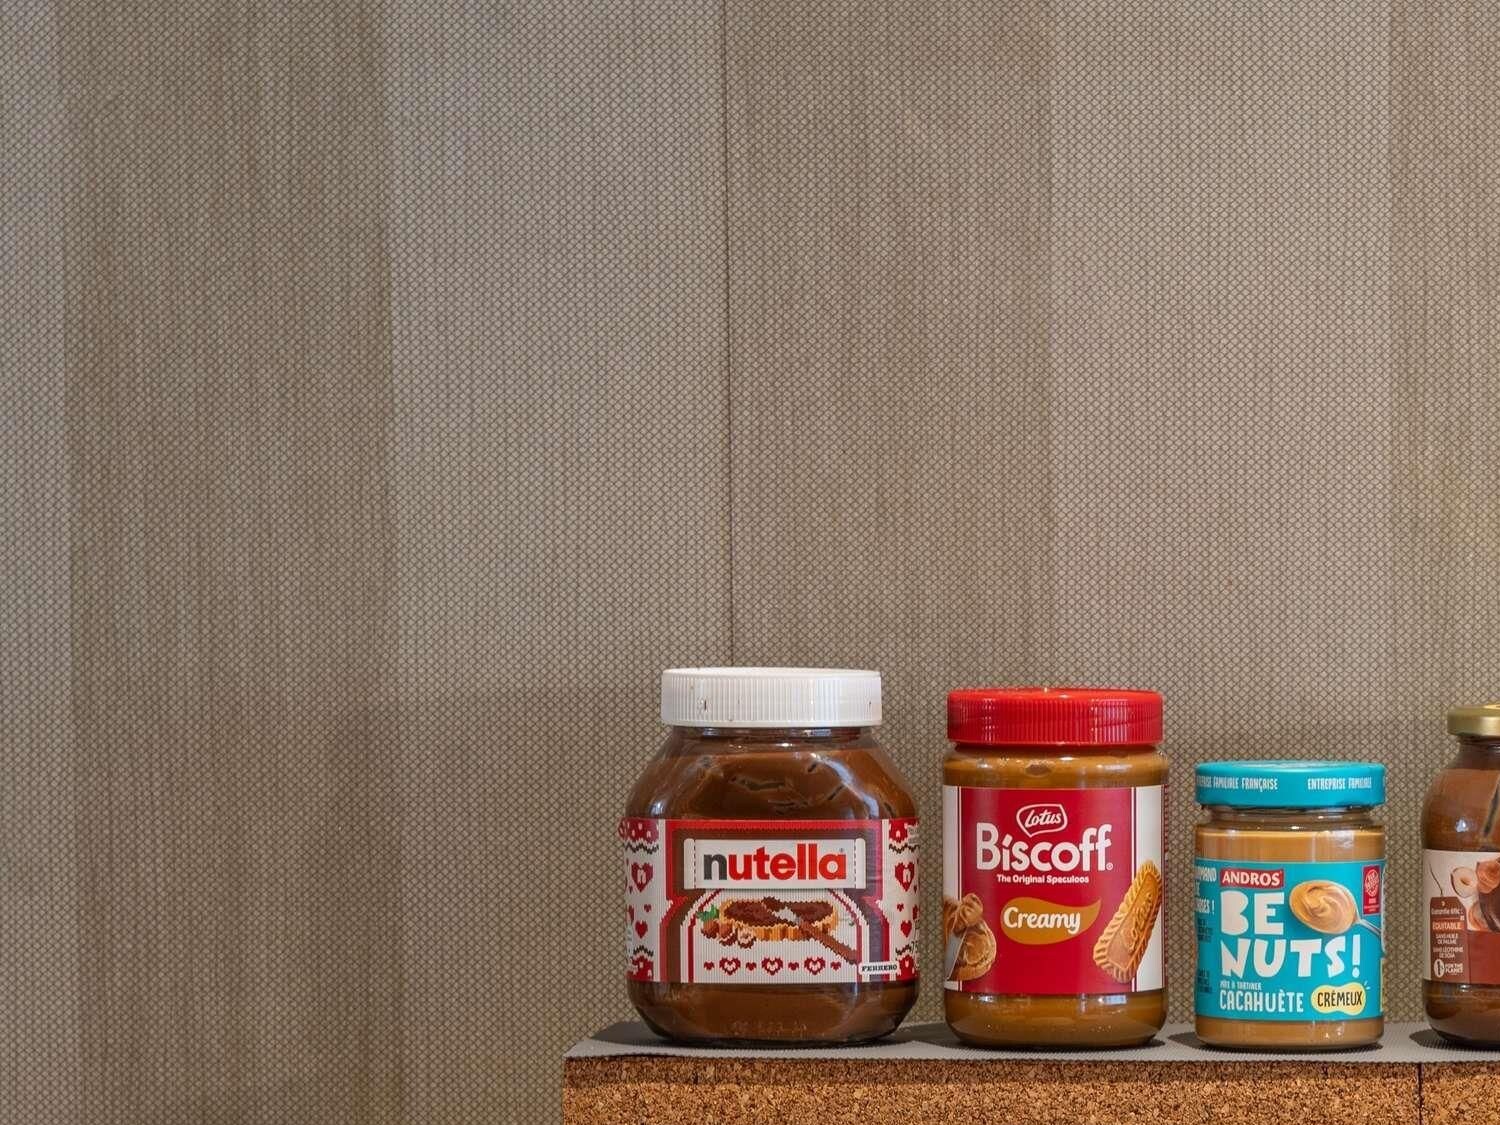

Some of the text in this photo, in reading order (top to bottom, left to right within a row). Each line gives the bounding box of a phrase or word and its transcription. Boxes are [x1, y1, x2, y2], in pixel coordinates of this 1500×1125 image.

[1307, 778, 1346, 790] ENTREPRISE
[1024, 809, 1062, 828] Lotus
[976, 822, 1112, 872] Biscoff
[703, 843, 847, 881] nutella
[996, 874, 1090, 885] The Original Speculoos
[1222, 871, 1281, 887] ANDROS
[1003, 906, 1081, 934] Creamy
[1221, 890, 1285, 935] BE
[1220, 934, 1361, 978] NUTS!
[1219, 987, 1304, 1013] CACAHUÈTE
[1317, 989, 1363, 1008] CRÉMEUX
